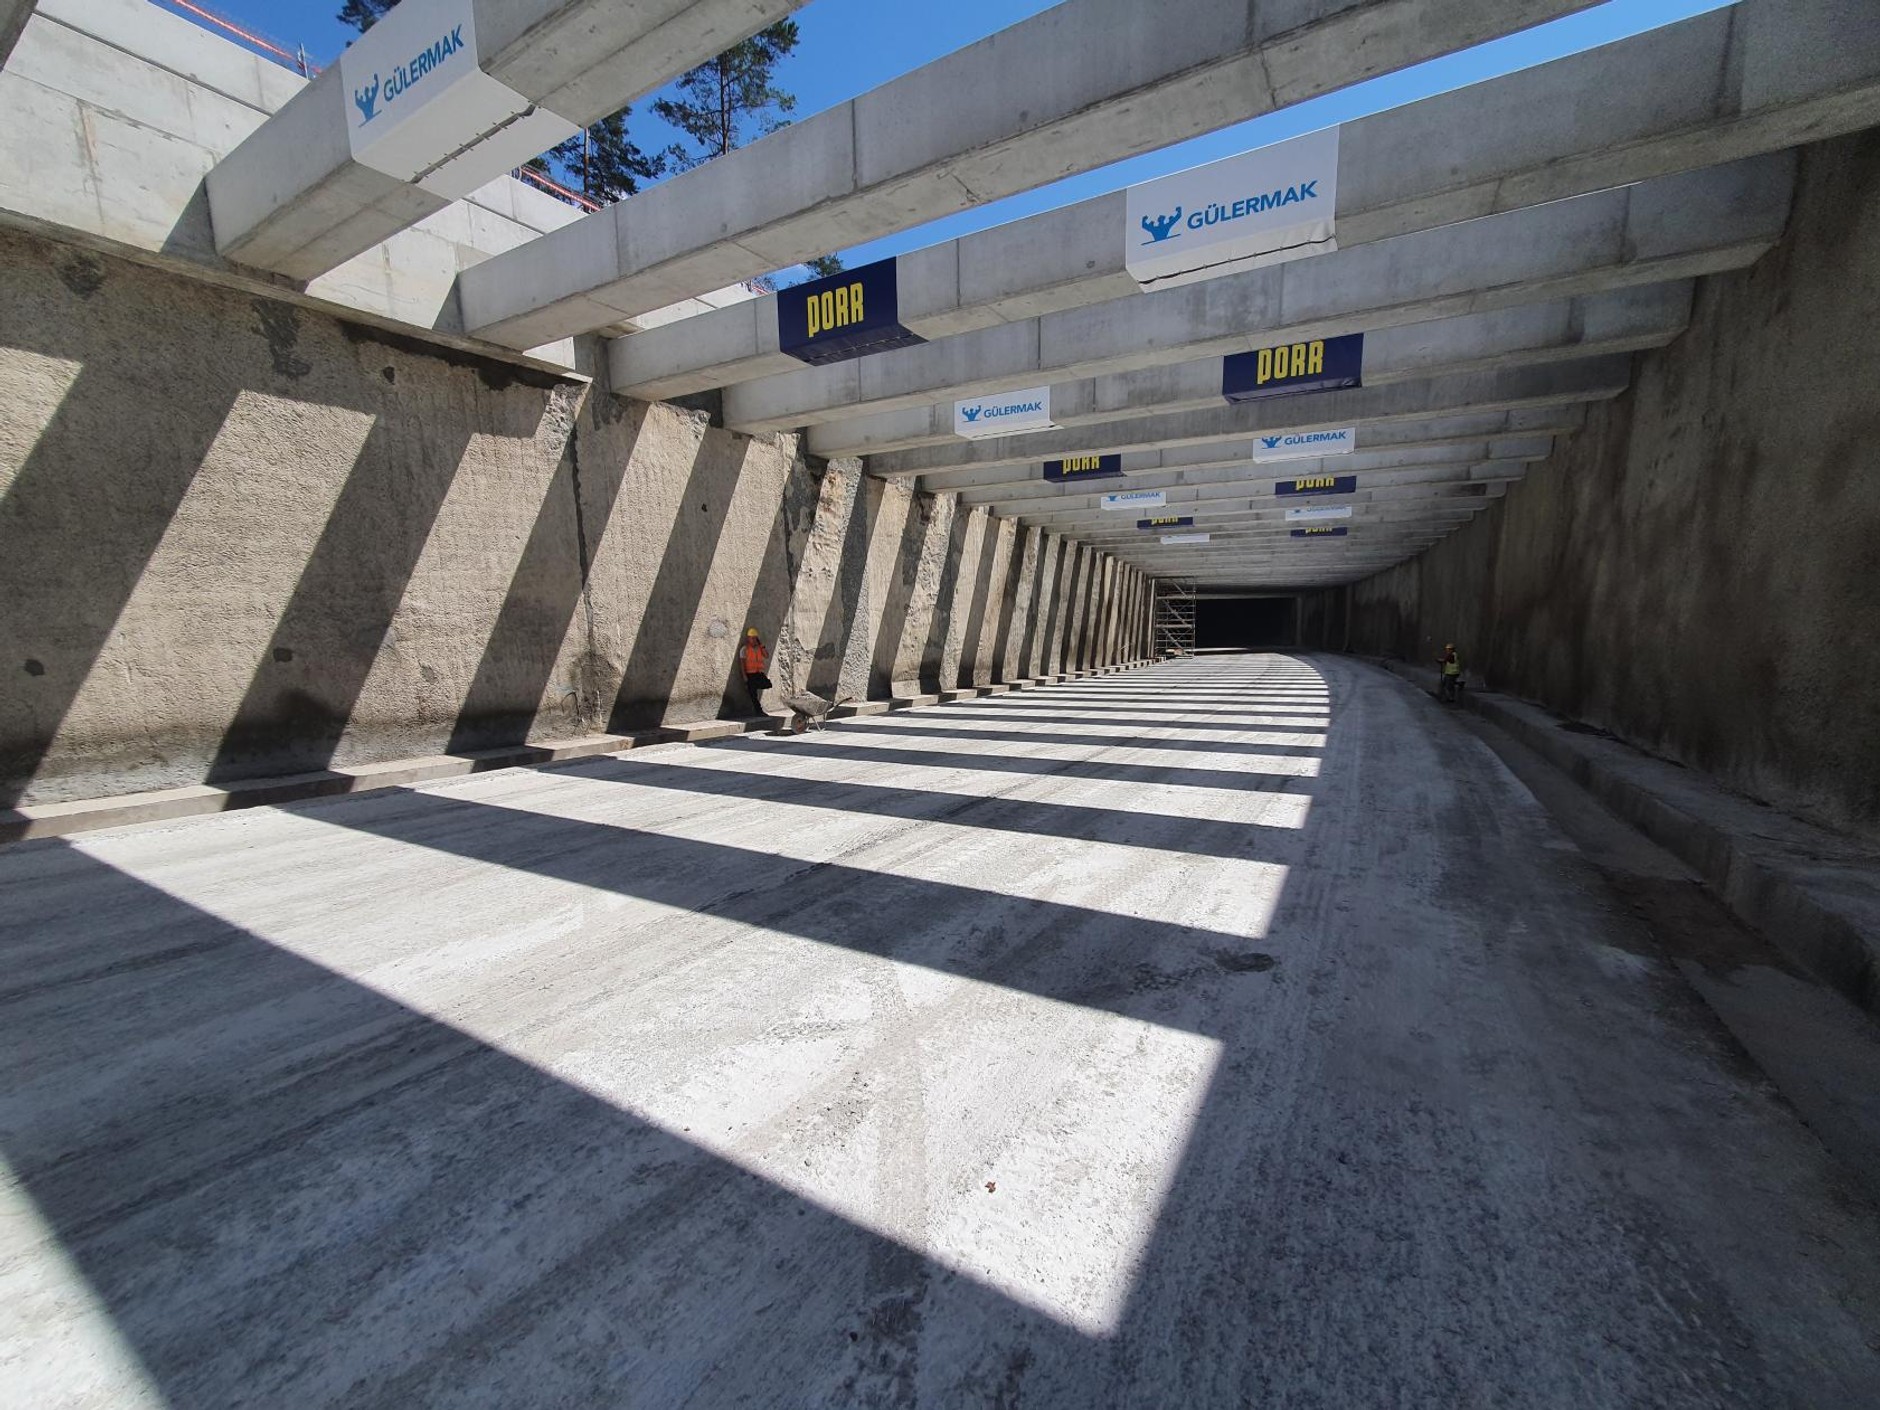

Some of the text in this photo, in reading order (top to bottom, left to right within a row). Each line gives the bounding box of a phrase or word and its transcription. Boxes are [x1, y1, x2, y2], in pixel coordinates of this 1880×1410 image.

[383, 24, 464, 102] GÜLERMAK
[1187, 180, 1318, 230] GÜLERMAK
[807, 282, 864, 338] PORR
[1257, 340, 1324, 385] PORR
[983, 402, 1042, 418] GÜLERMAK
